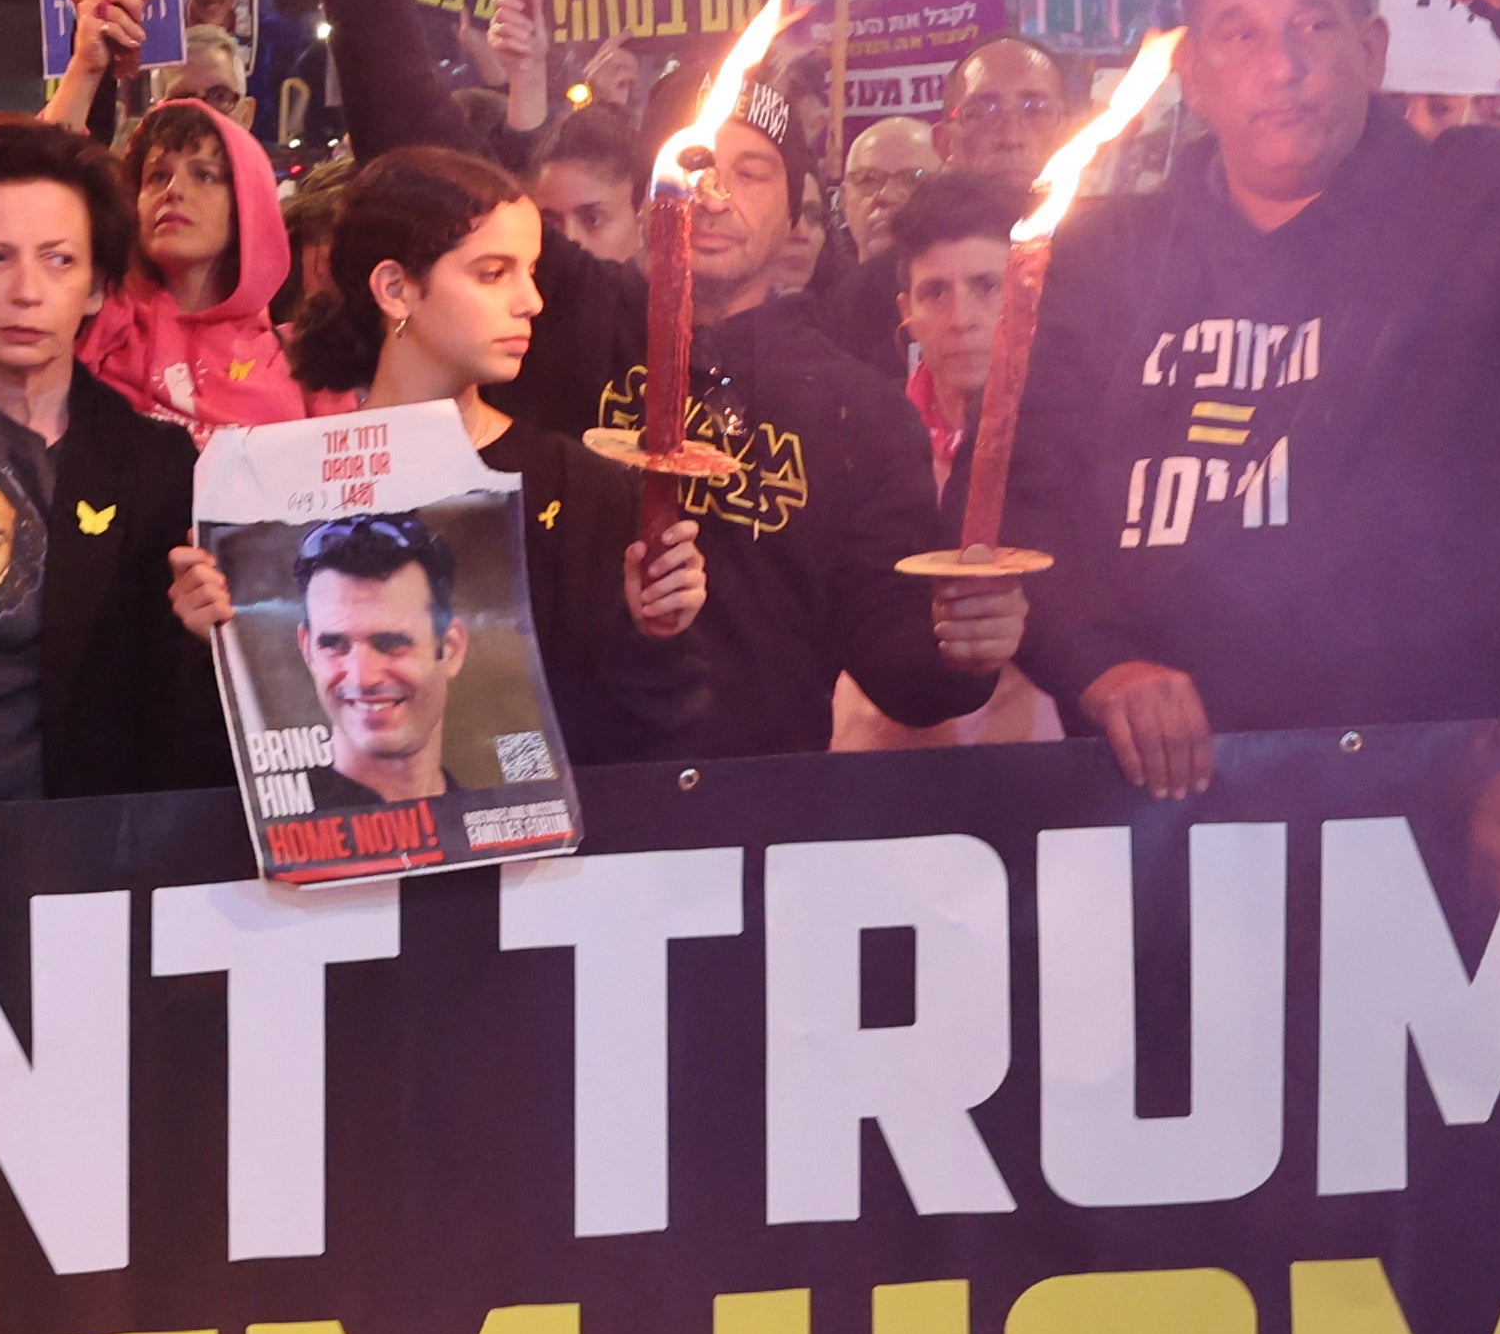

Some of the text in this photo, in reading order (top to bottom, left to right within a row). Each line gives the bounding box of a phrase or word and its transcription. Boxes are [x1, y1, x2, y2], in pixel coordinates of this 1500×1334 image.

[322, 429, 349, 454] אור
[322, 452, 392, 482] DROR OR
[246, 724, 333, 773] BRING
[255, 771, 316, 820] HIM
[266, 800, 438, 865] HOME NOW!
